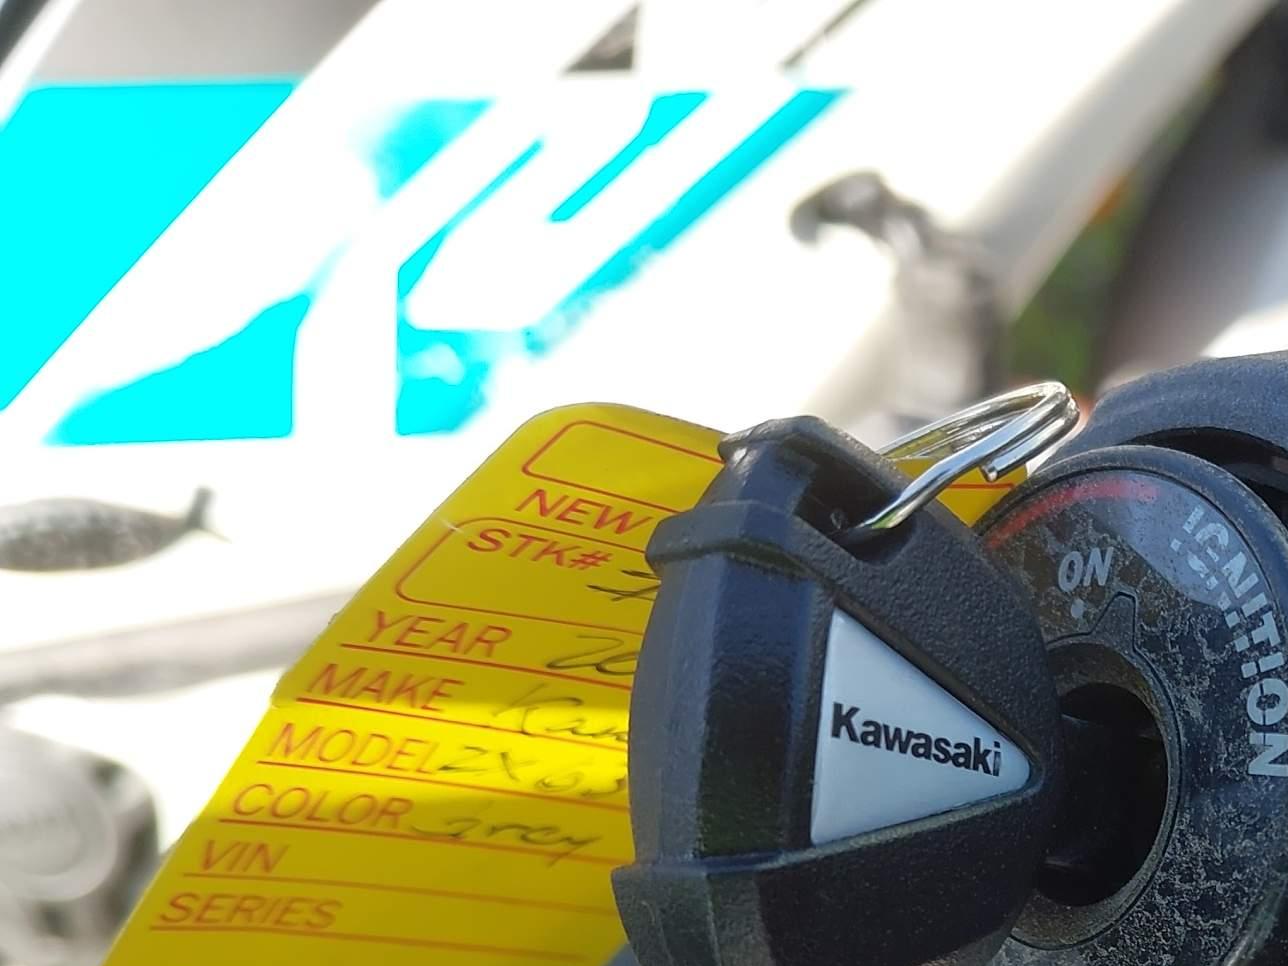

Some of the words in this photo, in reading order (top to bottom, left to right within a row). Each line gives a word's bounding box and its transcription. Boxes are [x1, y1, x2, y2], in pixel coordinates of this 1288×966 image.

[515, 488, 654, 535] NEW
[466, 528, 613, 570] STK#
[1058, 547, 1114, 593] ON
[367, 610, 513, 658] YEAR
[304, 662, 466, 712] MAKE
[266, 722, 441, 775] MODEL
[830, 702, 1002, 777] Kawasaki
[233, 782, 414, 829] COLOR
[201, 839, 290, 875] VIN
[158, 892, 343, 930] SERIES
